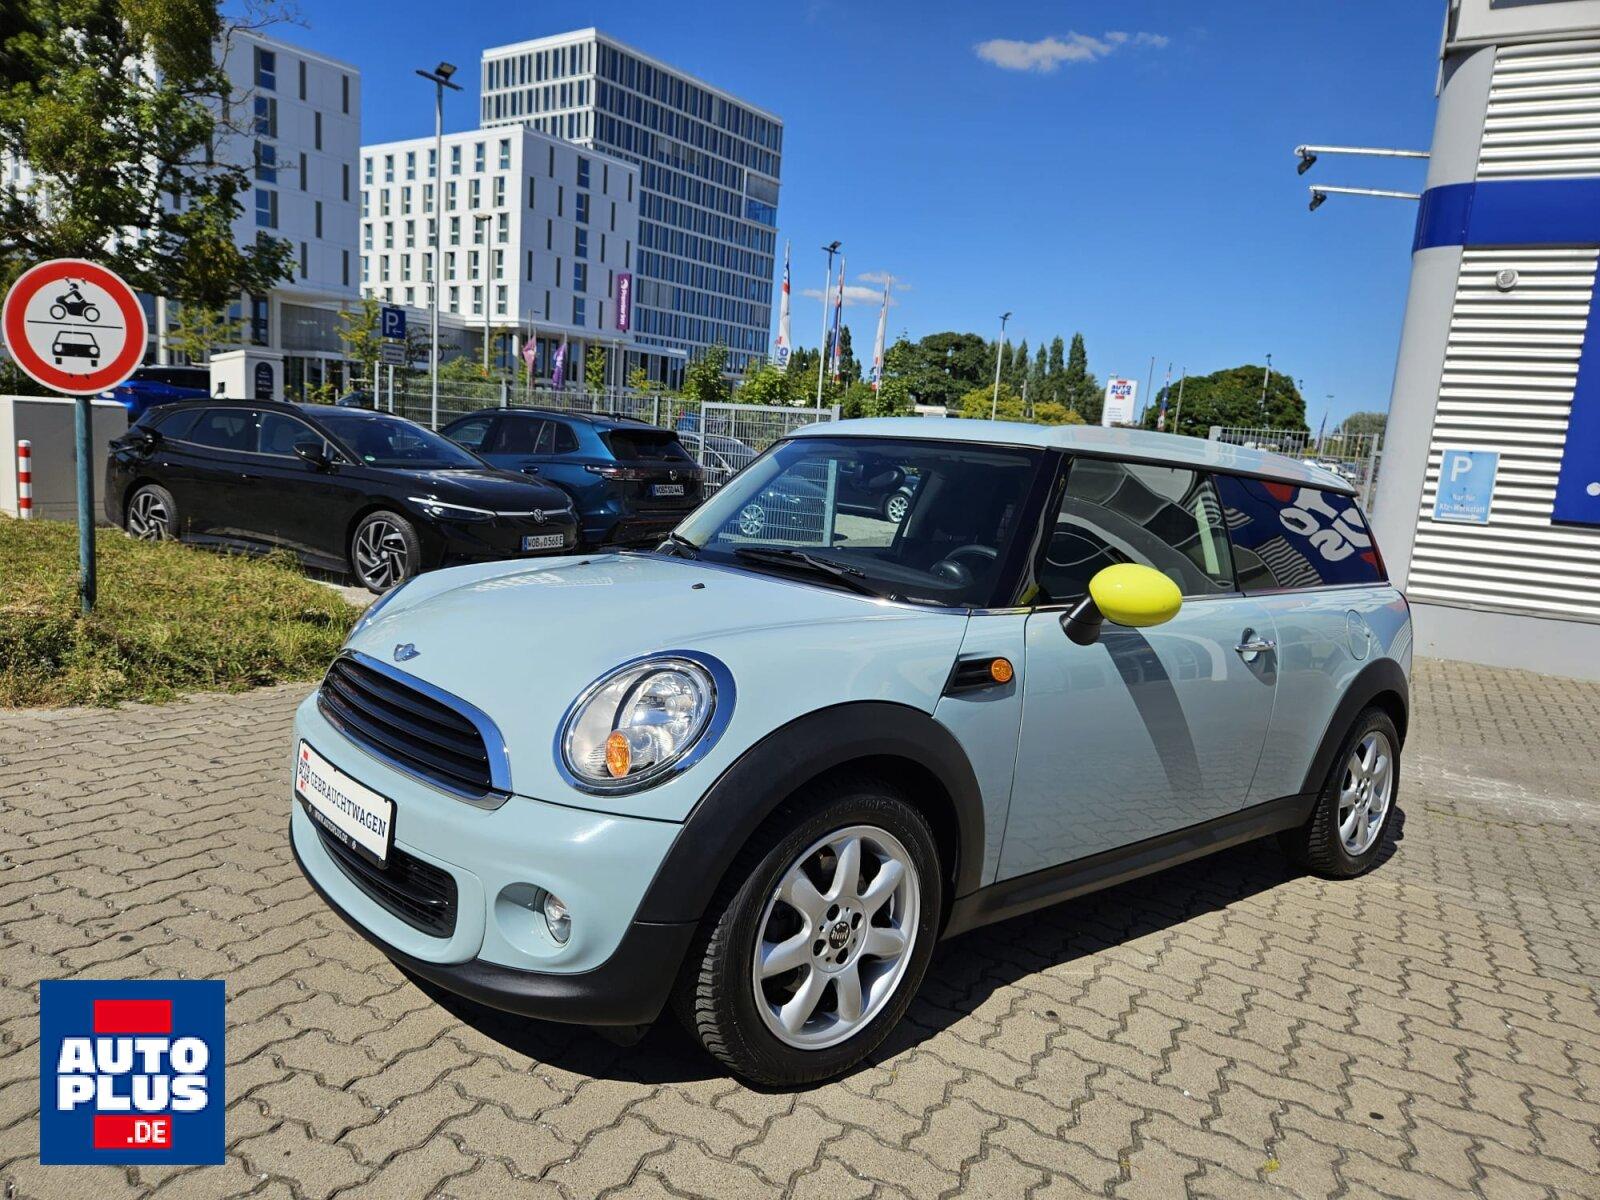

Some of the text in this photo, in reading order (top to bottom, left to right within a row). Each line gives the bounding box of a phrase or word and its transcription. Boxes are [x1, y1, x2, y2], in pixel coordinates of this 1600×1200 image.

[385, 311, 399, 334] P
[1450, 455, 1473, 482] P
[310, 771, 387, 839] GEBRAUCHTWAGEN
